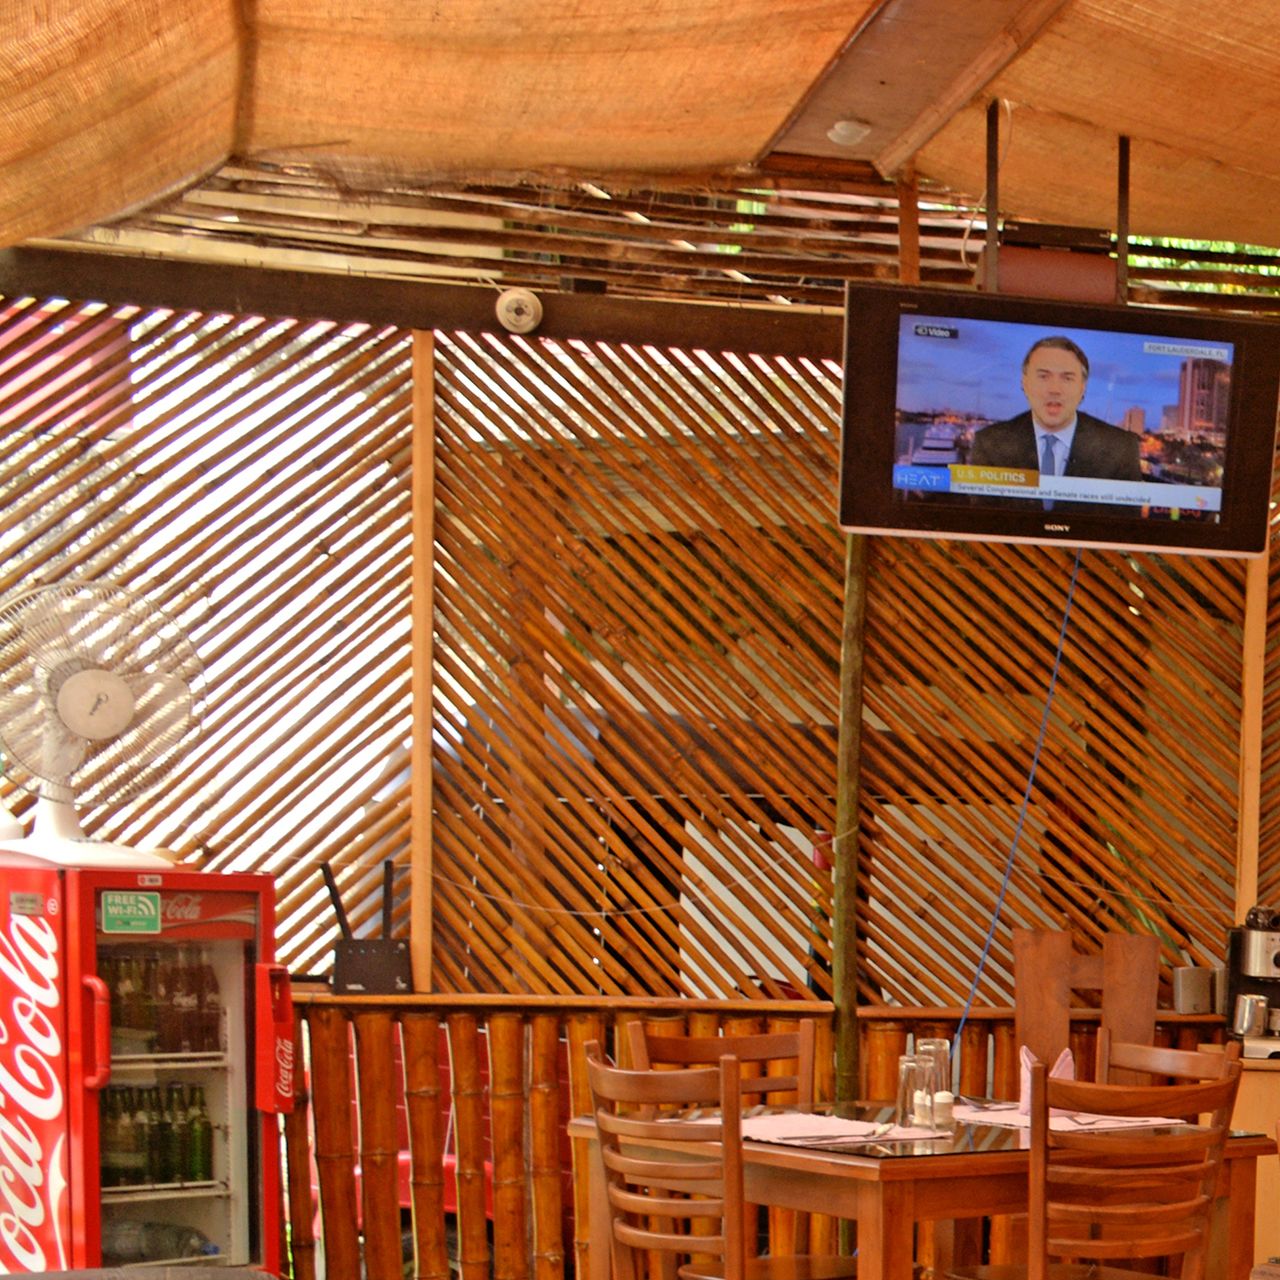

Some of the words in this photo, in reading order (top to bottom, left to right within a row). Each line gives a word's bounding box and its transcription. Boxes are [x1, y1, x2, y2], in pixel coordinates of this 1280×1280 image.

[928, 327, 950, 337] Video
[896, 473, 941, 486] HEAT
[957, 469, 975, 479] U.S.
[979, 470, 1026, 482] POLITICS
[1053, 490, 1077, 498] Senate
[1044, 523, 1070, 532] SONY
[107, 894, 135, 904] FREE
